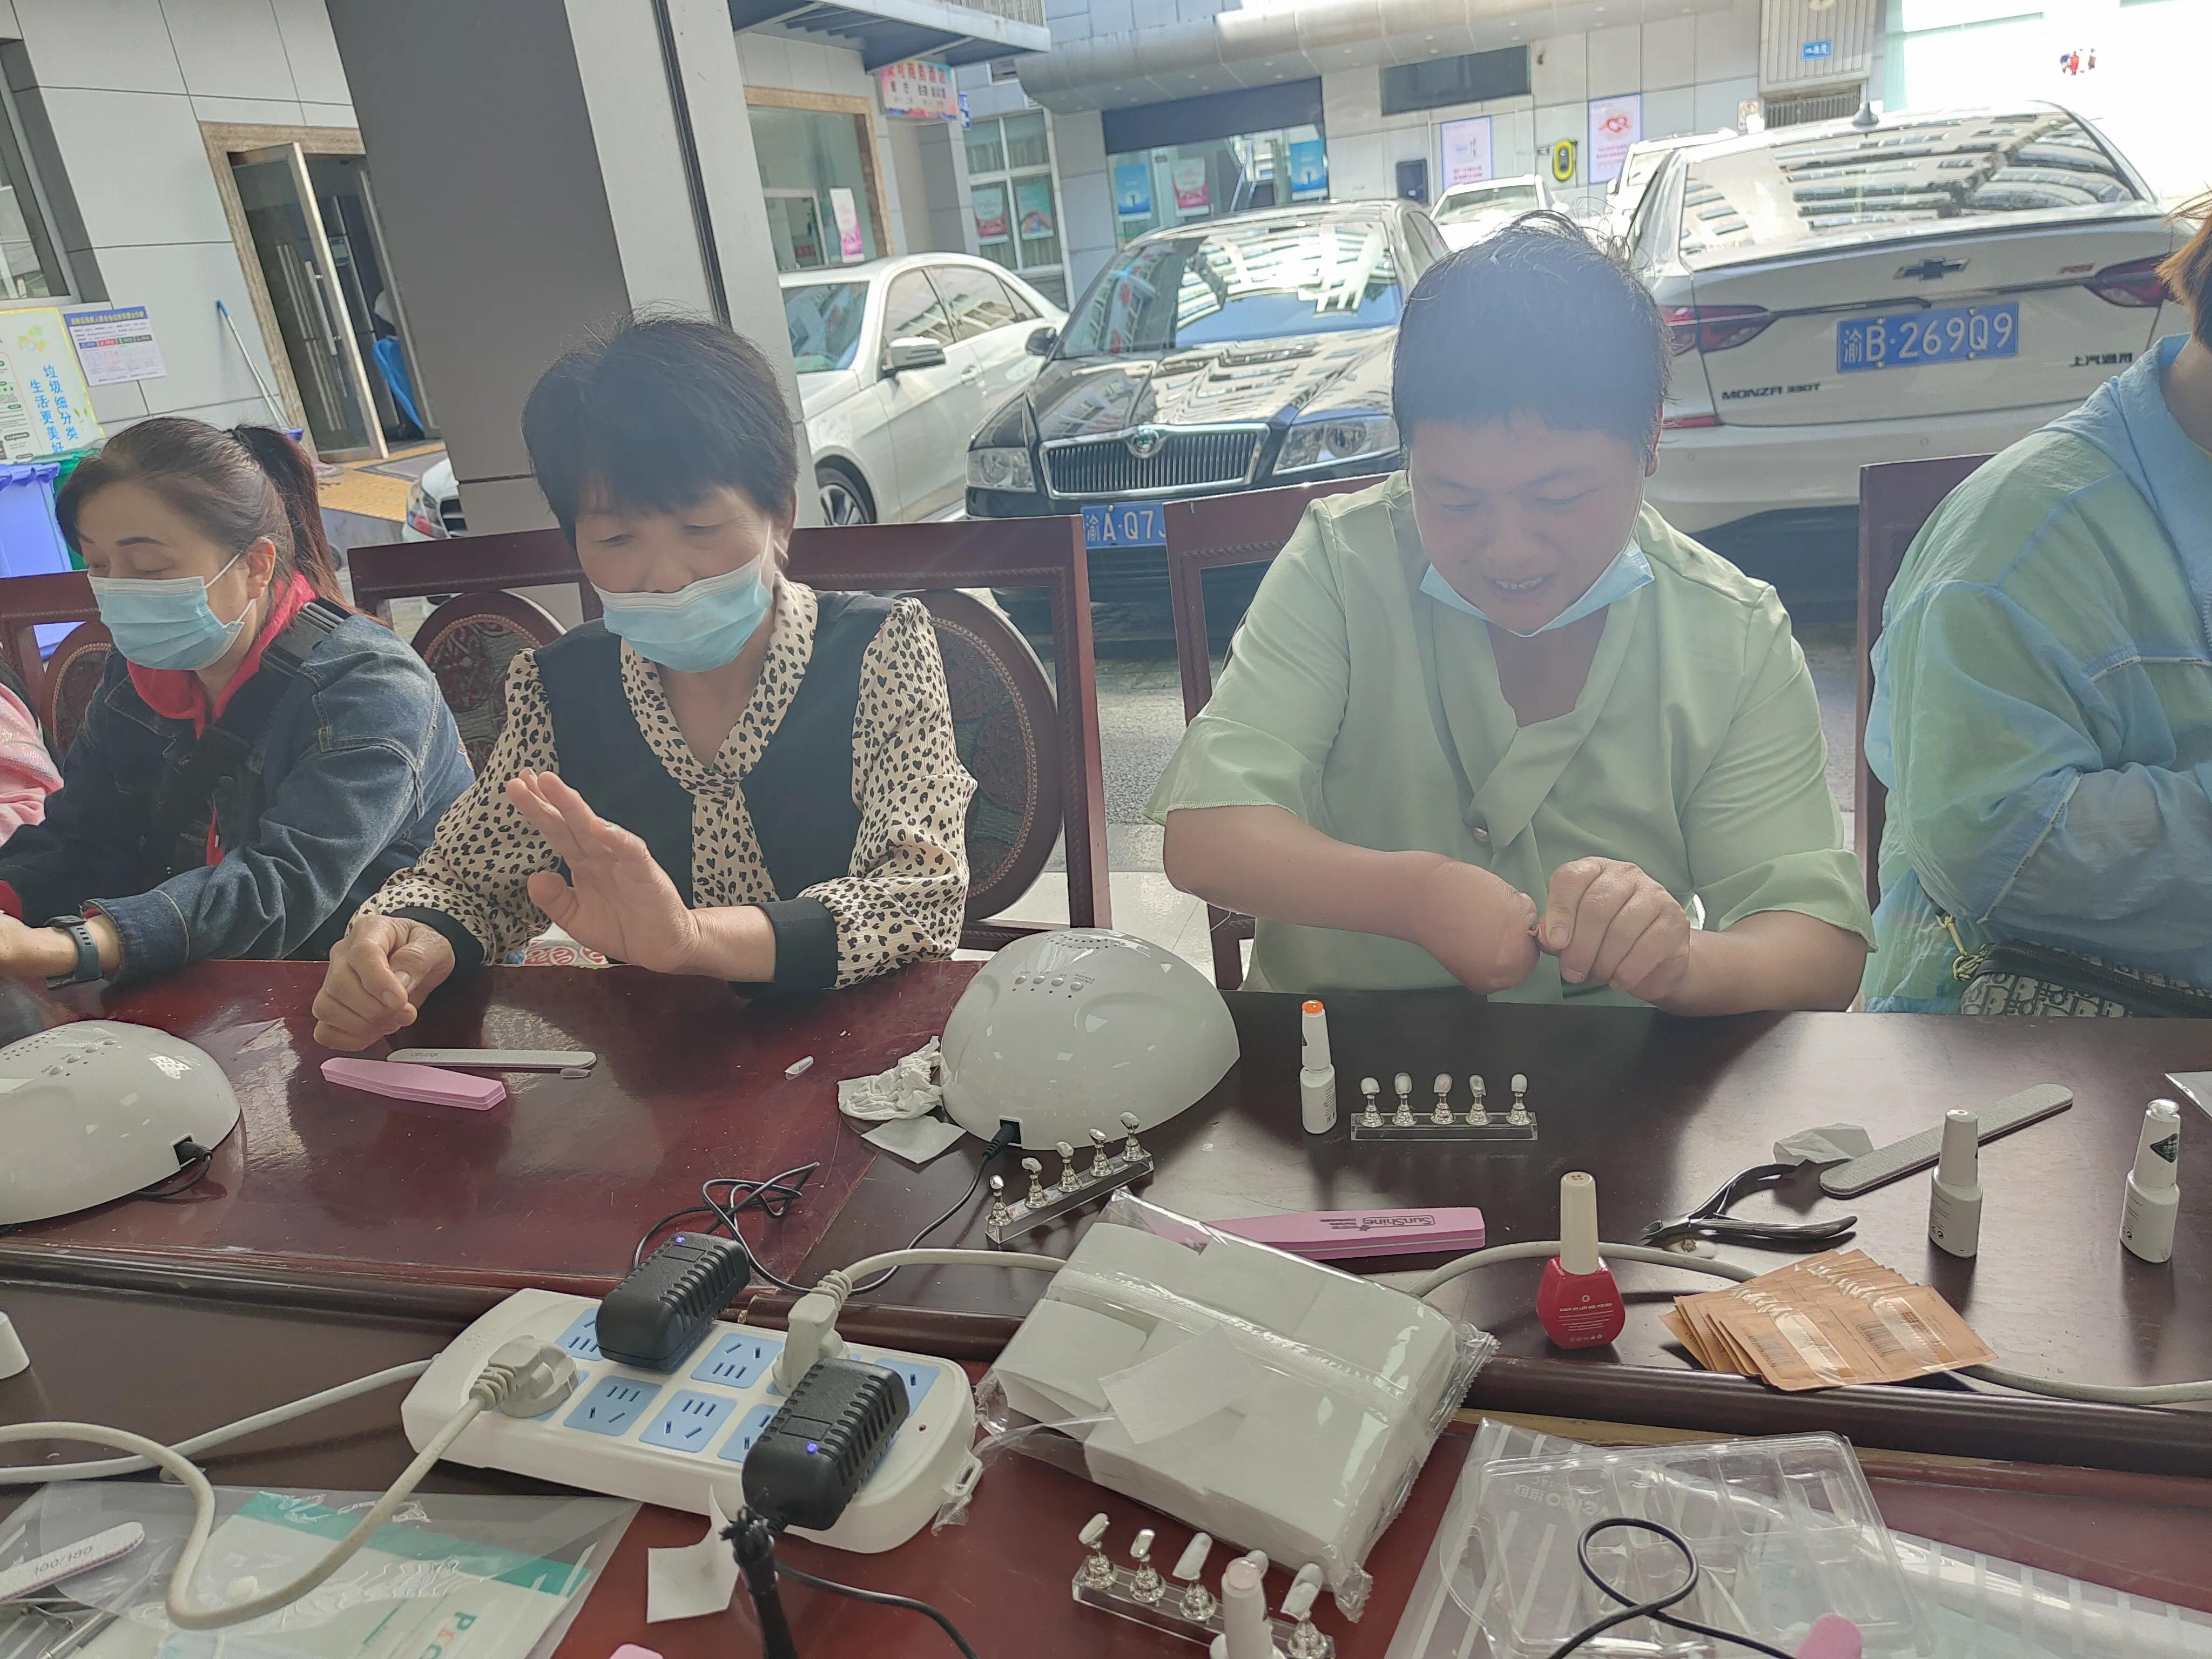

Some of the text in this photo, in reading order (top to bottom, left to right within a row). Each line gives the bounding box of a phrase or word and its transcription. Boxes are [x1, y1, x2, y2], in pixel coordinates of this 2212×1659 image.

[1843, 312, 2013, 363] 渝B·269Q9
[1722, 386, 1782, 401] MONZA
[30, 379, 64, 453] 生活更美好
[1085, 510, 1166, 542] 渝A·Q7
[1365, 1216, 1432, 1225] SunShine
